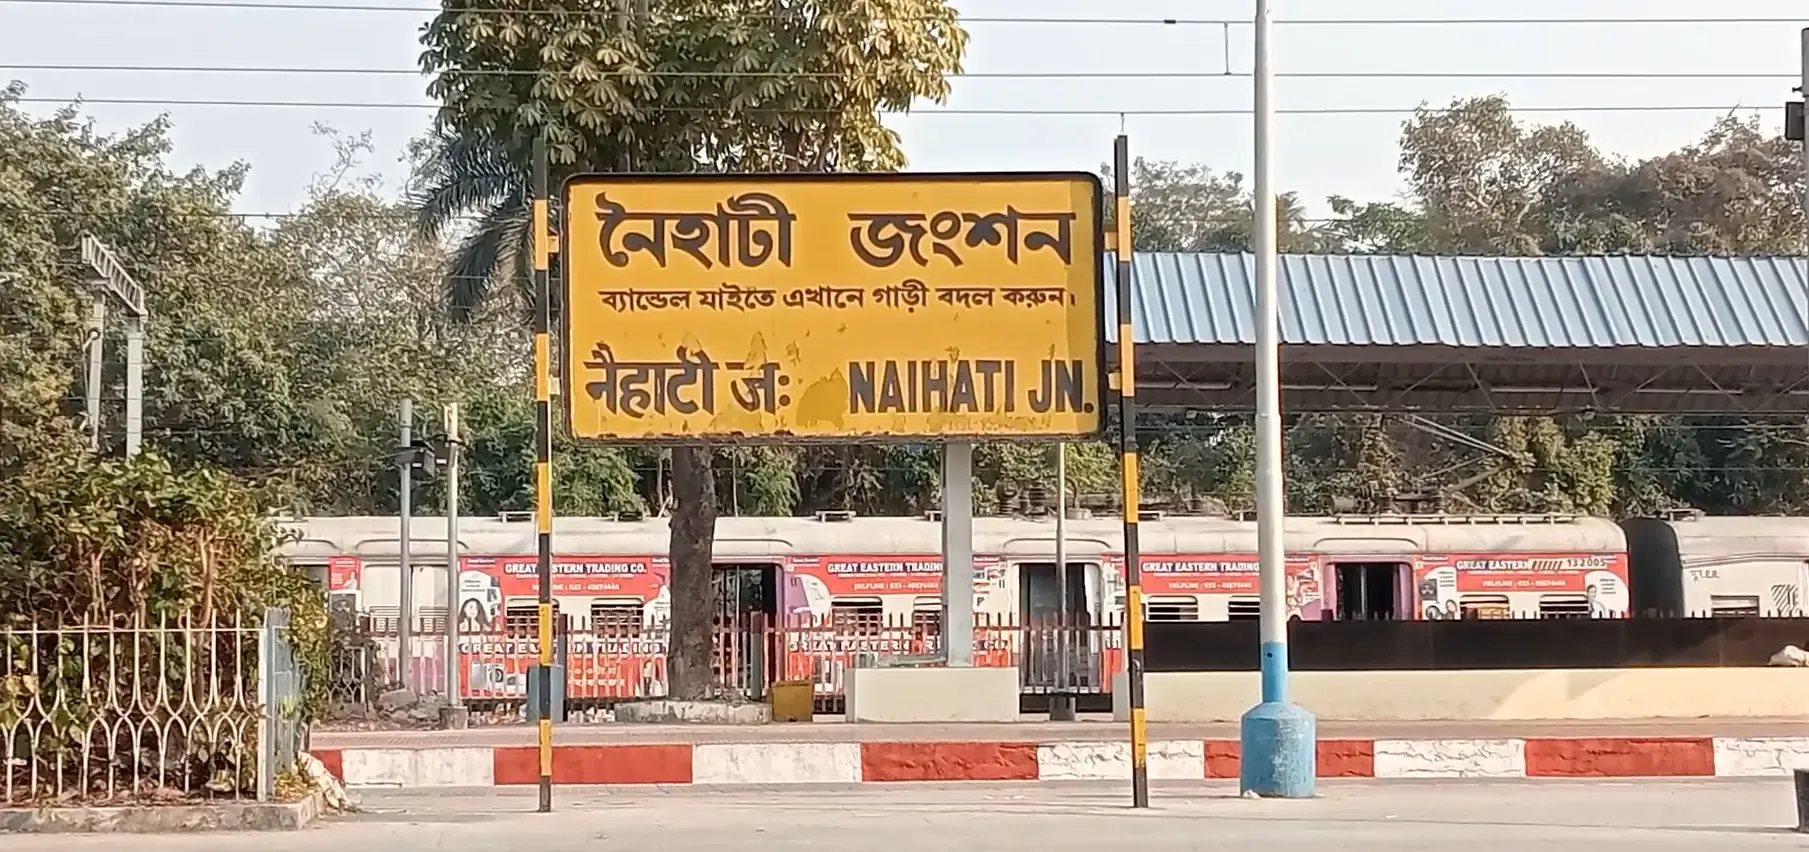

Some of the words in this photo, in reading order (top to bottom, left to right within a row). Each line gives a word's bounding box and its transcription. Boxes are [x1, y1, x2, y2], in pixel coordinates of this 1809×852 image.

[596, 192, 796, 268] নৈহাটী
[848, 205, 1077, 268] জংশন
[697, 282, 776, 311] যাইতে
[783, 284, 865, 308] এখানে
[873, 278, 930, 313] গাড়ী
[936, 287, 995, 308] বদল
[583, 342, 719, 419] नैहाटी
[849, 359, 1015, 414] NAIHATI
[1028, 359, 1094, 414] JN.
[828, 563, 858, 573] GREAT
[860, 563, 903, 573] EASTERN
[905, 563, 943, 573] TRADIN
[1142, 562, 1173, 572] GREAT
[1175, 562, 1217, 572] EASTERN
[1456, 560, 1487, 570] GREAT
[1567, 558, 1606, 568] 132005
[505, 564, 538, 574] GREAT
[586, 564, 629, 575] TRADING
[629, 564, 647, 575] CO.
